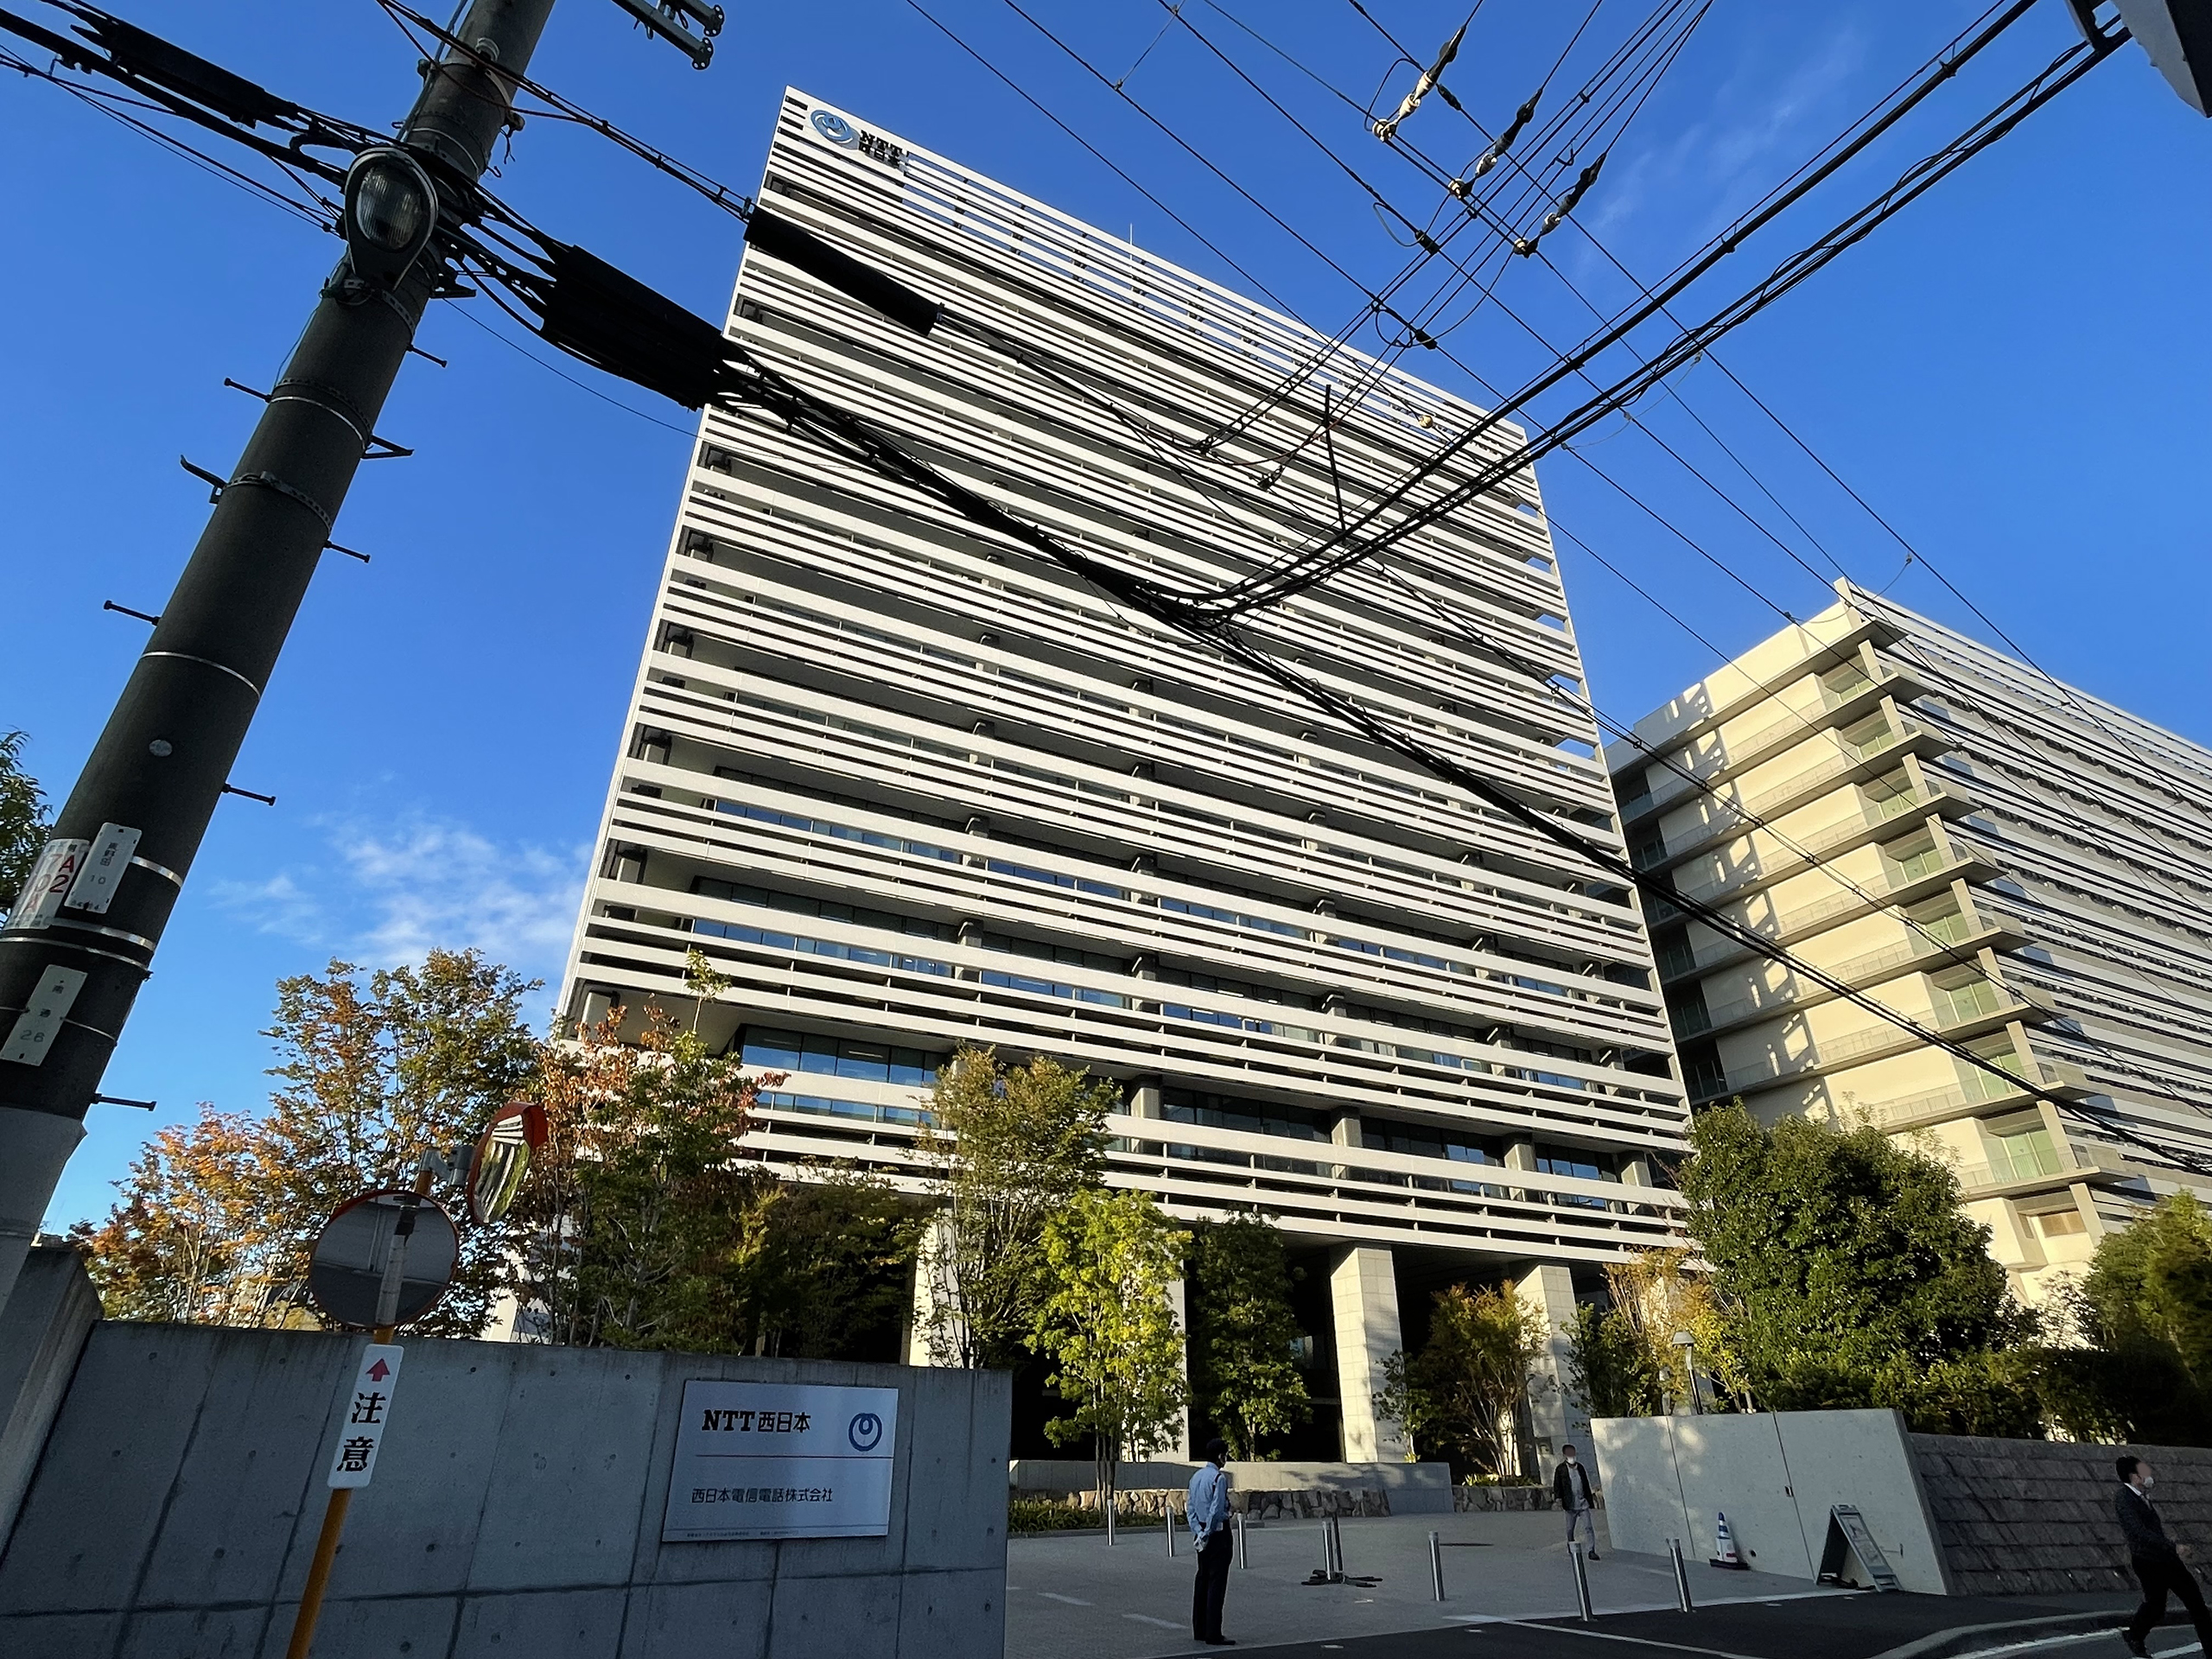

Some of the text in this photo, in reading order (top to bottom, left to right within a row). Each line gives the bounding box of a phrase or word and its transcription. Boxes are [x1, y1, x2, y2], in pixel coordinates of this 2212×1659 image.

[860, 130, 902, 157] NTT
[336, 1392, 386, 1471] 注意
[691, 1488, 834, 1503] 西日本電信電話株式会社
